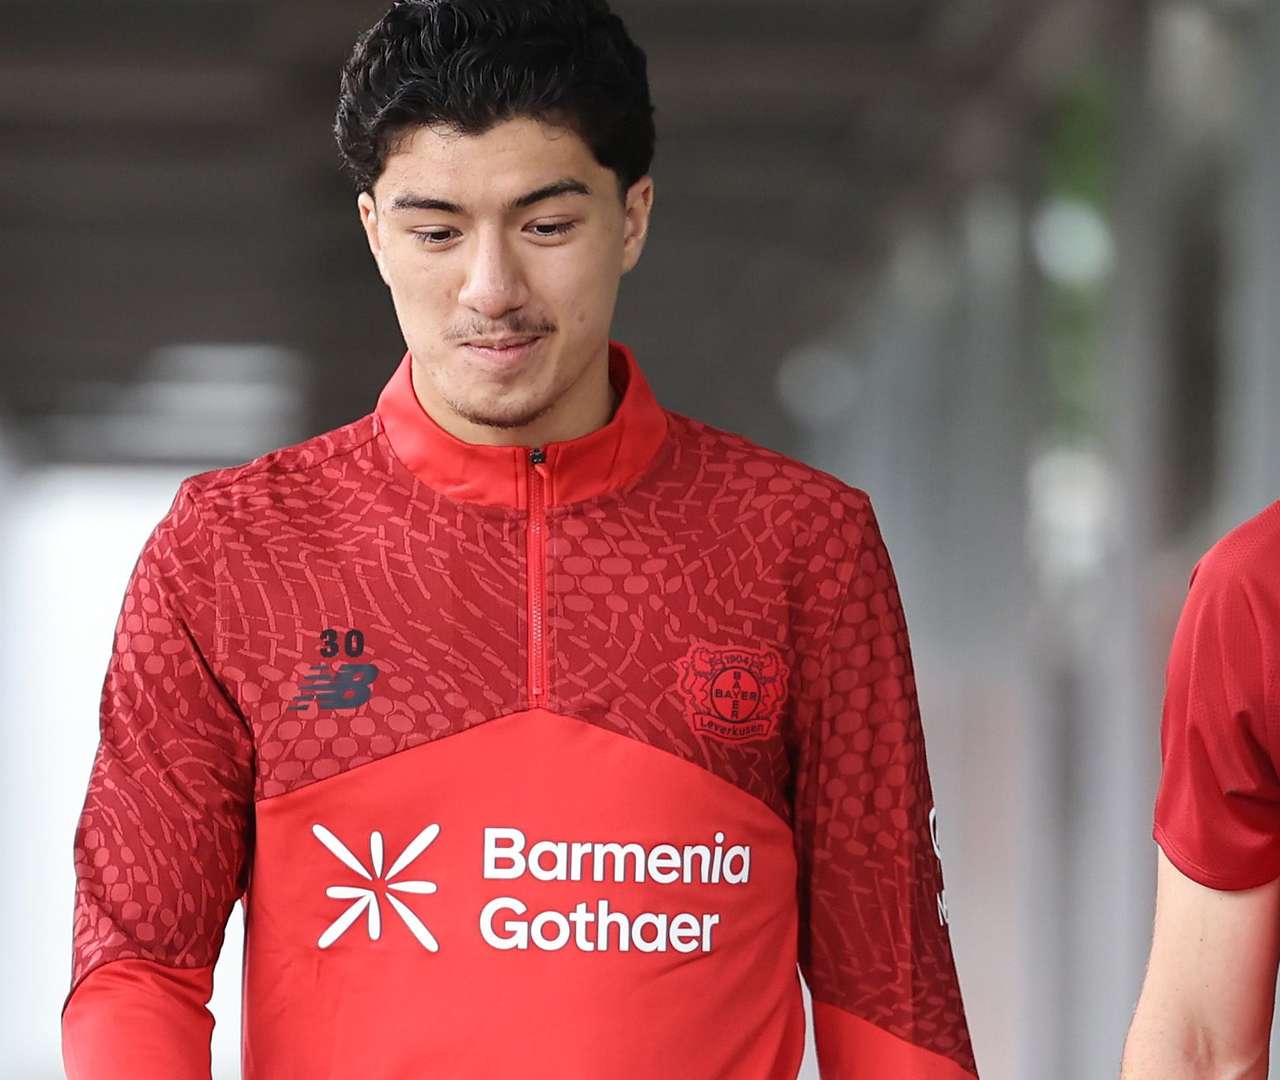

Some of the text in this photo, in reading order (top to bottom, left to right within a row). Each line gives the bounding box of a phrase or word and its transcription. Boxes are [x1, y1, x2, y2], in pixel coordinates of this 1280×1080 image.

[320, 629, 365, 658] 30
[714, 688, 757, 699] BAYER
[699, 717, 764, 737] Leverkusen
[483, 827, 751, 884] Barmenia
[479, 897, 720, 953] Gothaer
